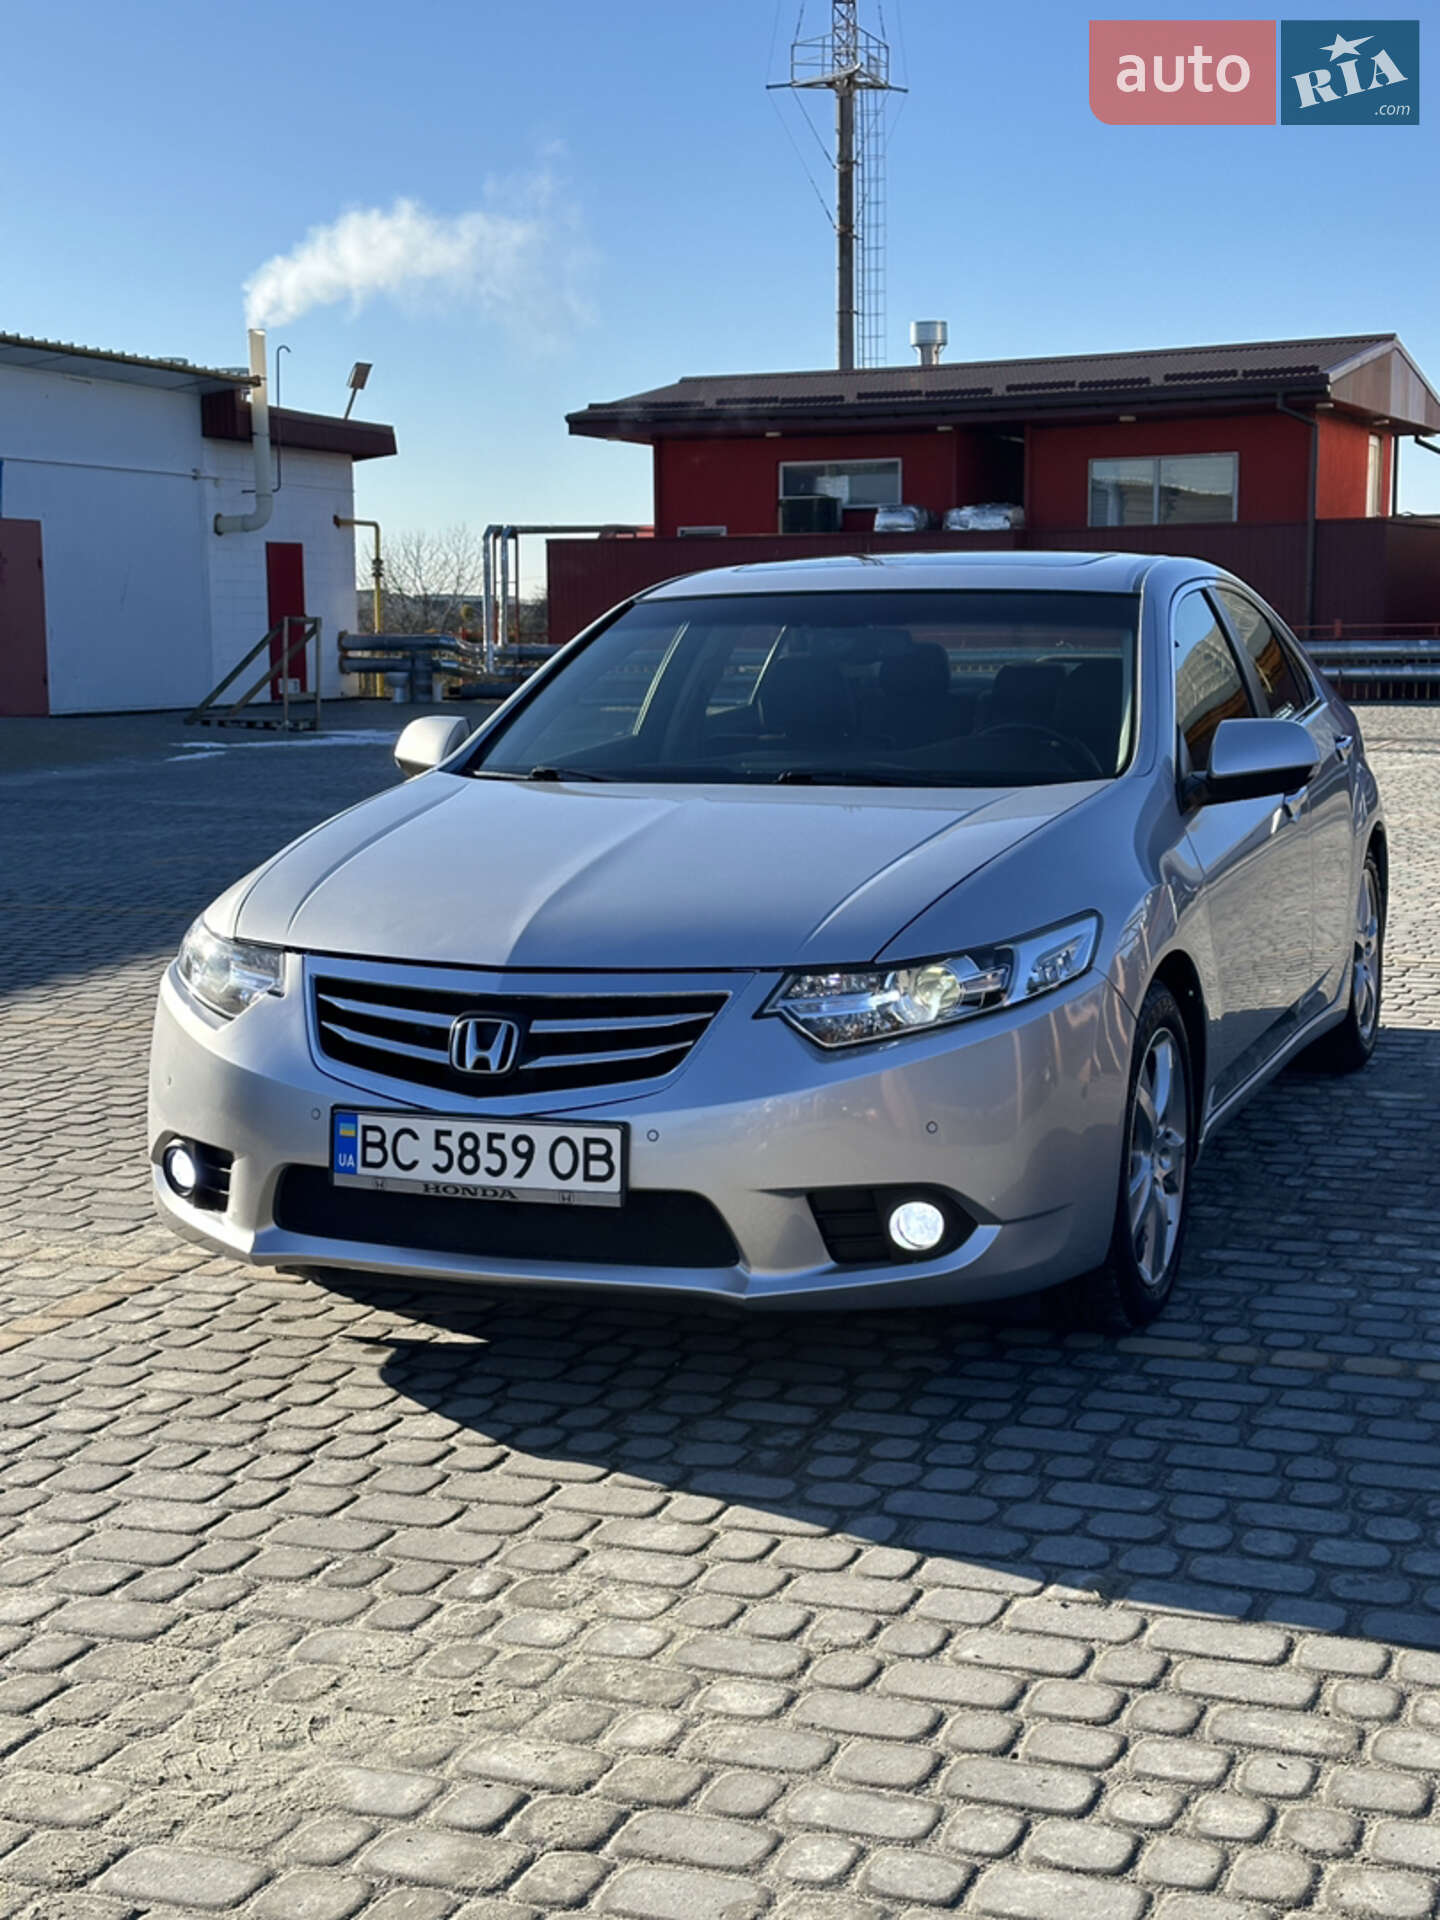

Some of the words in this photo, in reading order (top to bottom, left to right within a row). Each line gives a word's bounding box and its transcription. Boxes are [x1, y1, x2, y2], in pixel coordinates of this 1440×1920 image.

[338, 1152, 355, 1168] UA
[361, 1124, 420, 1172] BC
[431, 1129, 536, 1179] 5859
[549, 1135, 616, 1183] OB
[422, 1182, 519, 1200] HONDA
